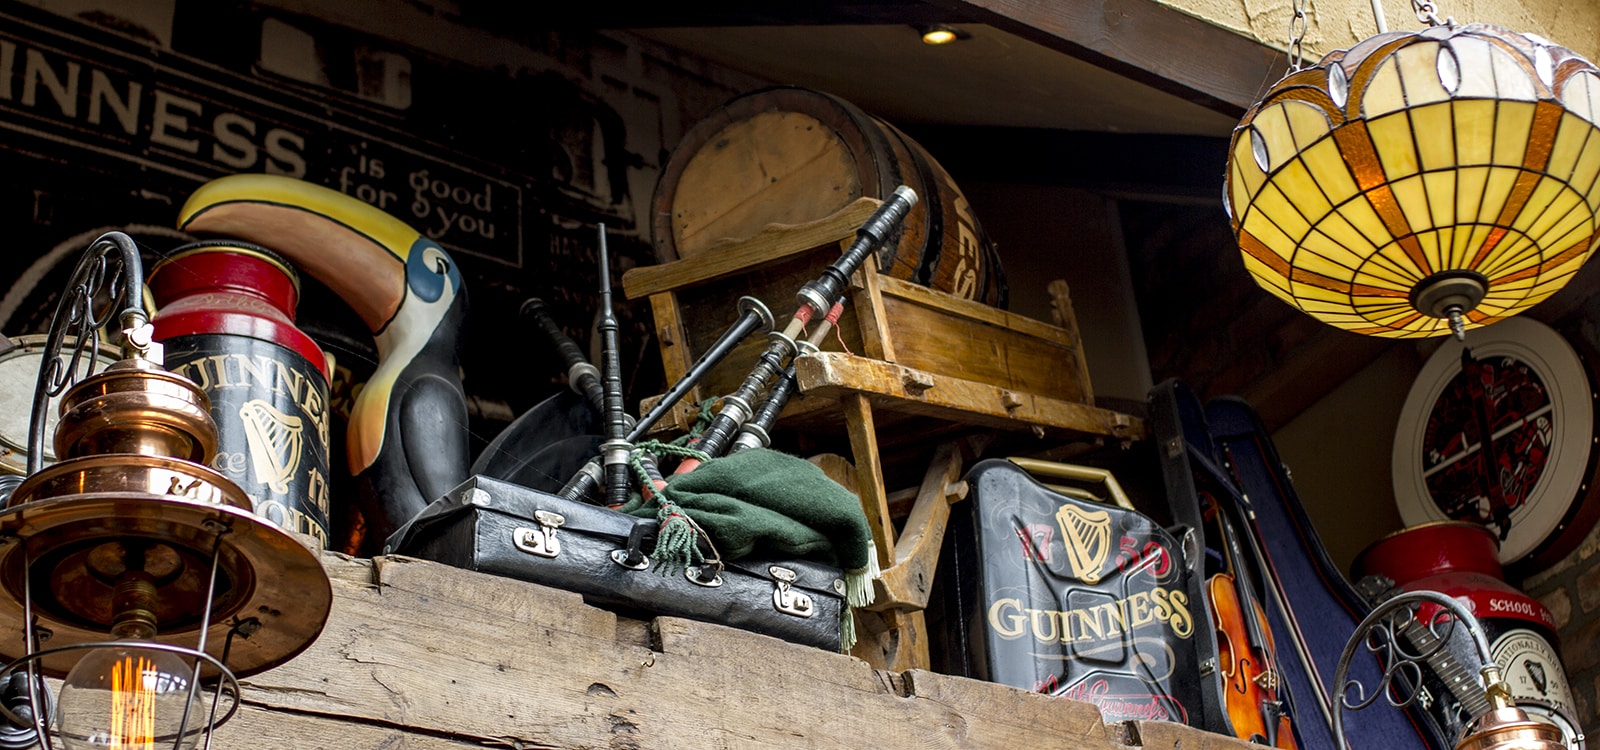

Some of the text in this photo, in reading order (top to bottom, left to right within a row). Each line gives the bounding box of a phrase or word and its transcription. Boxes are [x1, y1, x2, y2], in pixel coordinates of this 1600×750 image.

[339, 165, 496, 240] for you
[358, 141, 493, 219] is good
[1015, 523, 1171, 578] 17 59
[988, 587, 1194, 640] GUINNESS
[1489, 598, 1536, 617] SCHOOL
